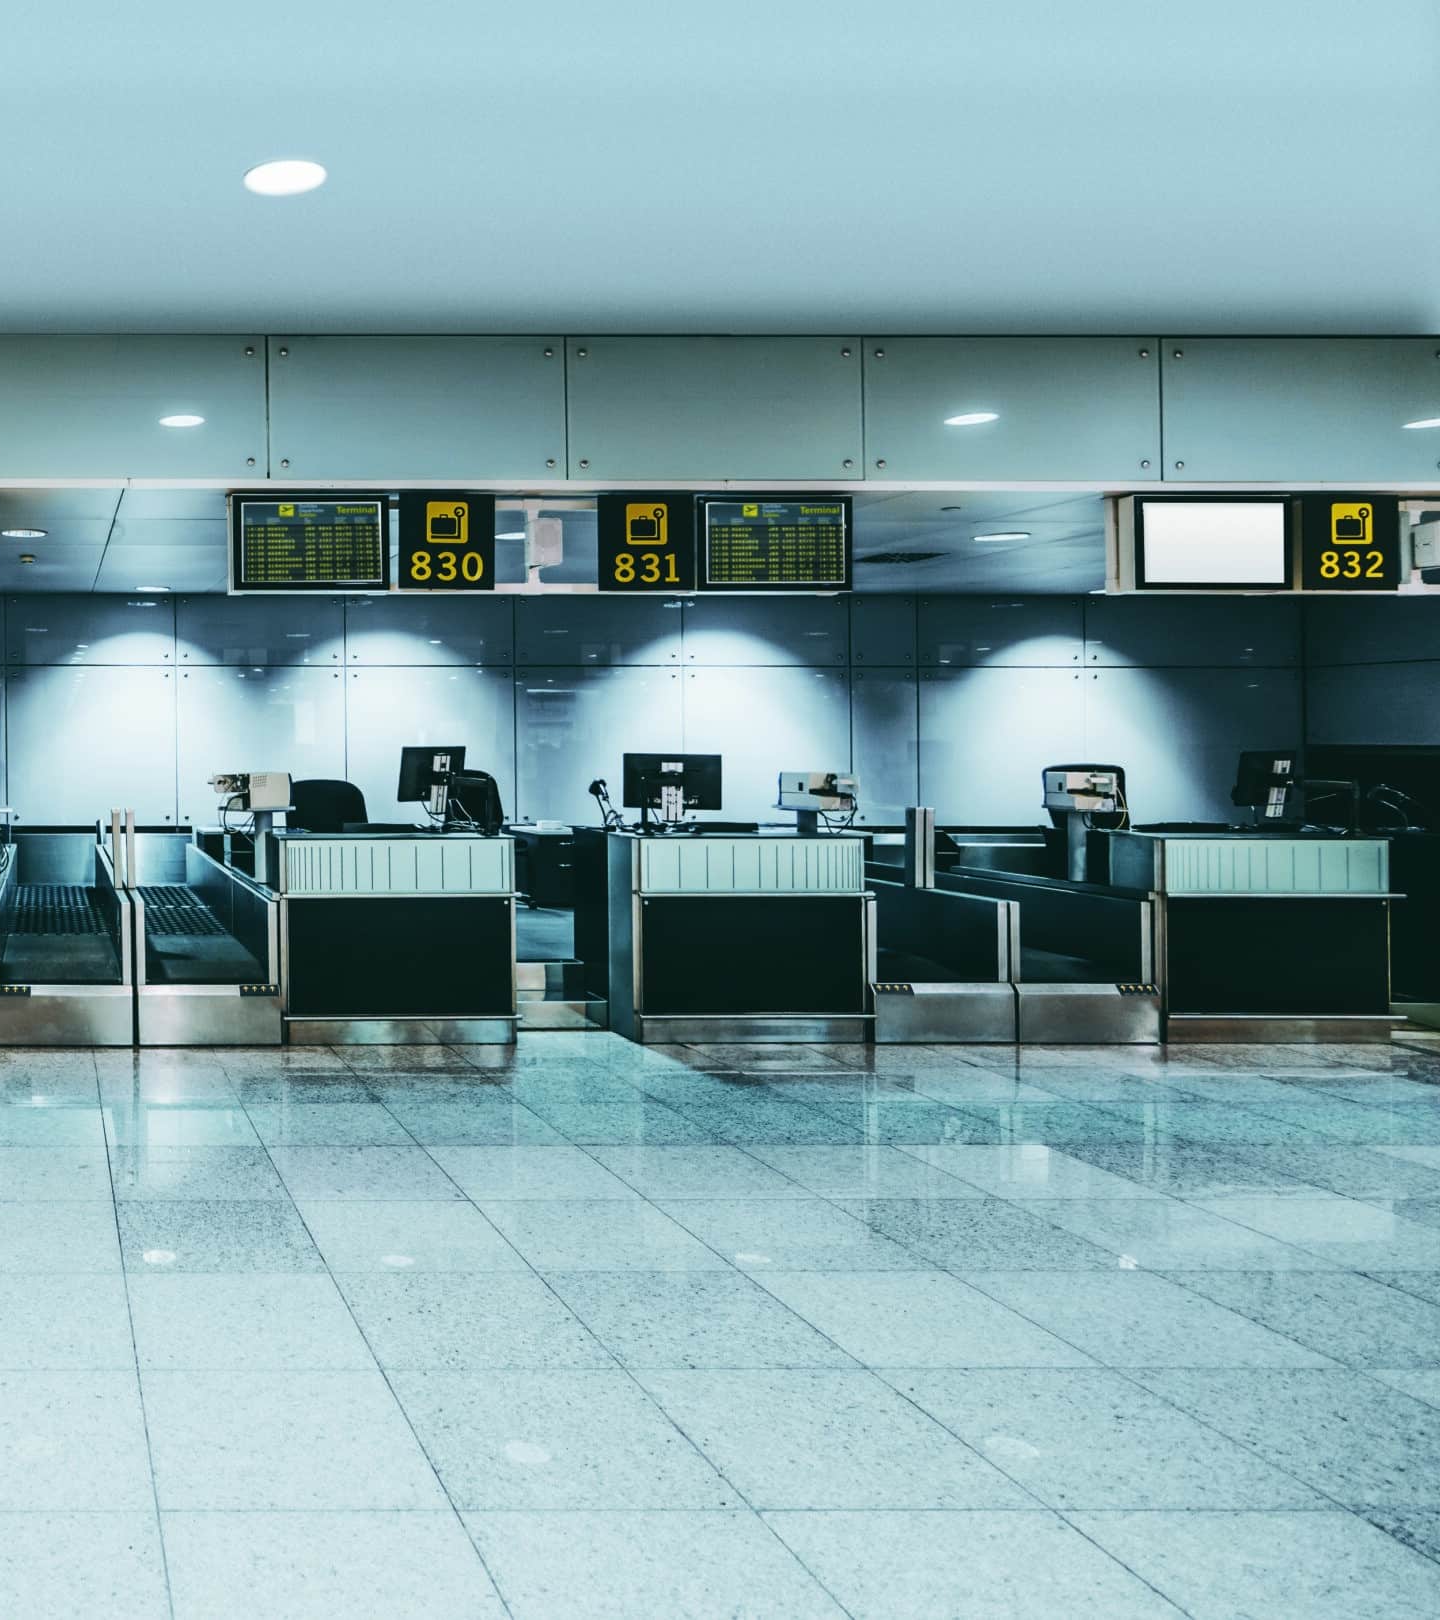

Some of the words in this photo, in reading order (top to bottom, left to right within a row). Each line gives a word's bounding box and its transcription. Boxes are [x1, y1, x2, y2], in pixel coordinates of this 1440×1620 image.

[336, 506, 376, 514] Terminal
[800, 506, 840, 514] Terminal
[410, 550, 484, 582] 830
[614, 552, 680, 583] 831
[1319, 550, 1384, 579] 832
